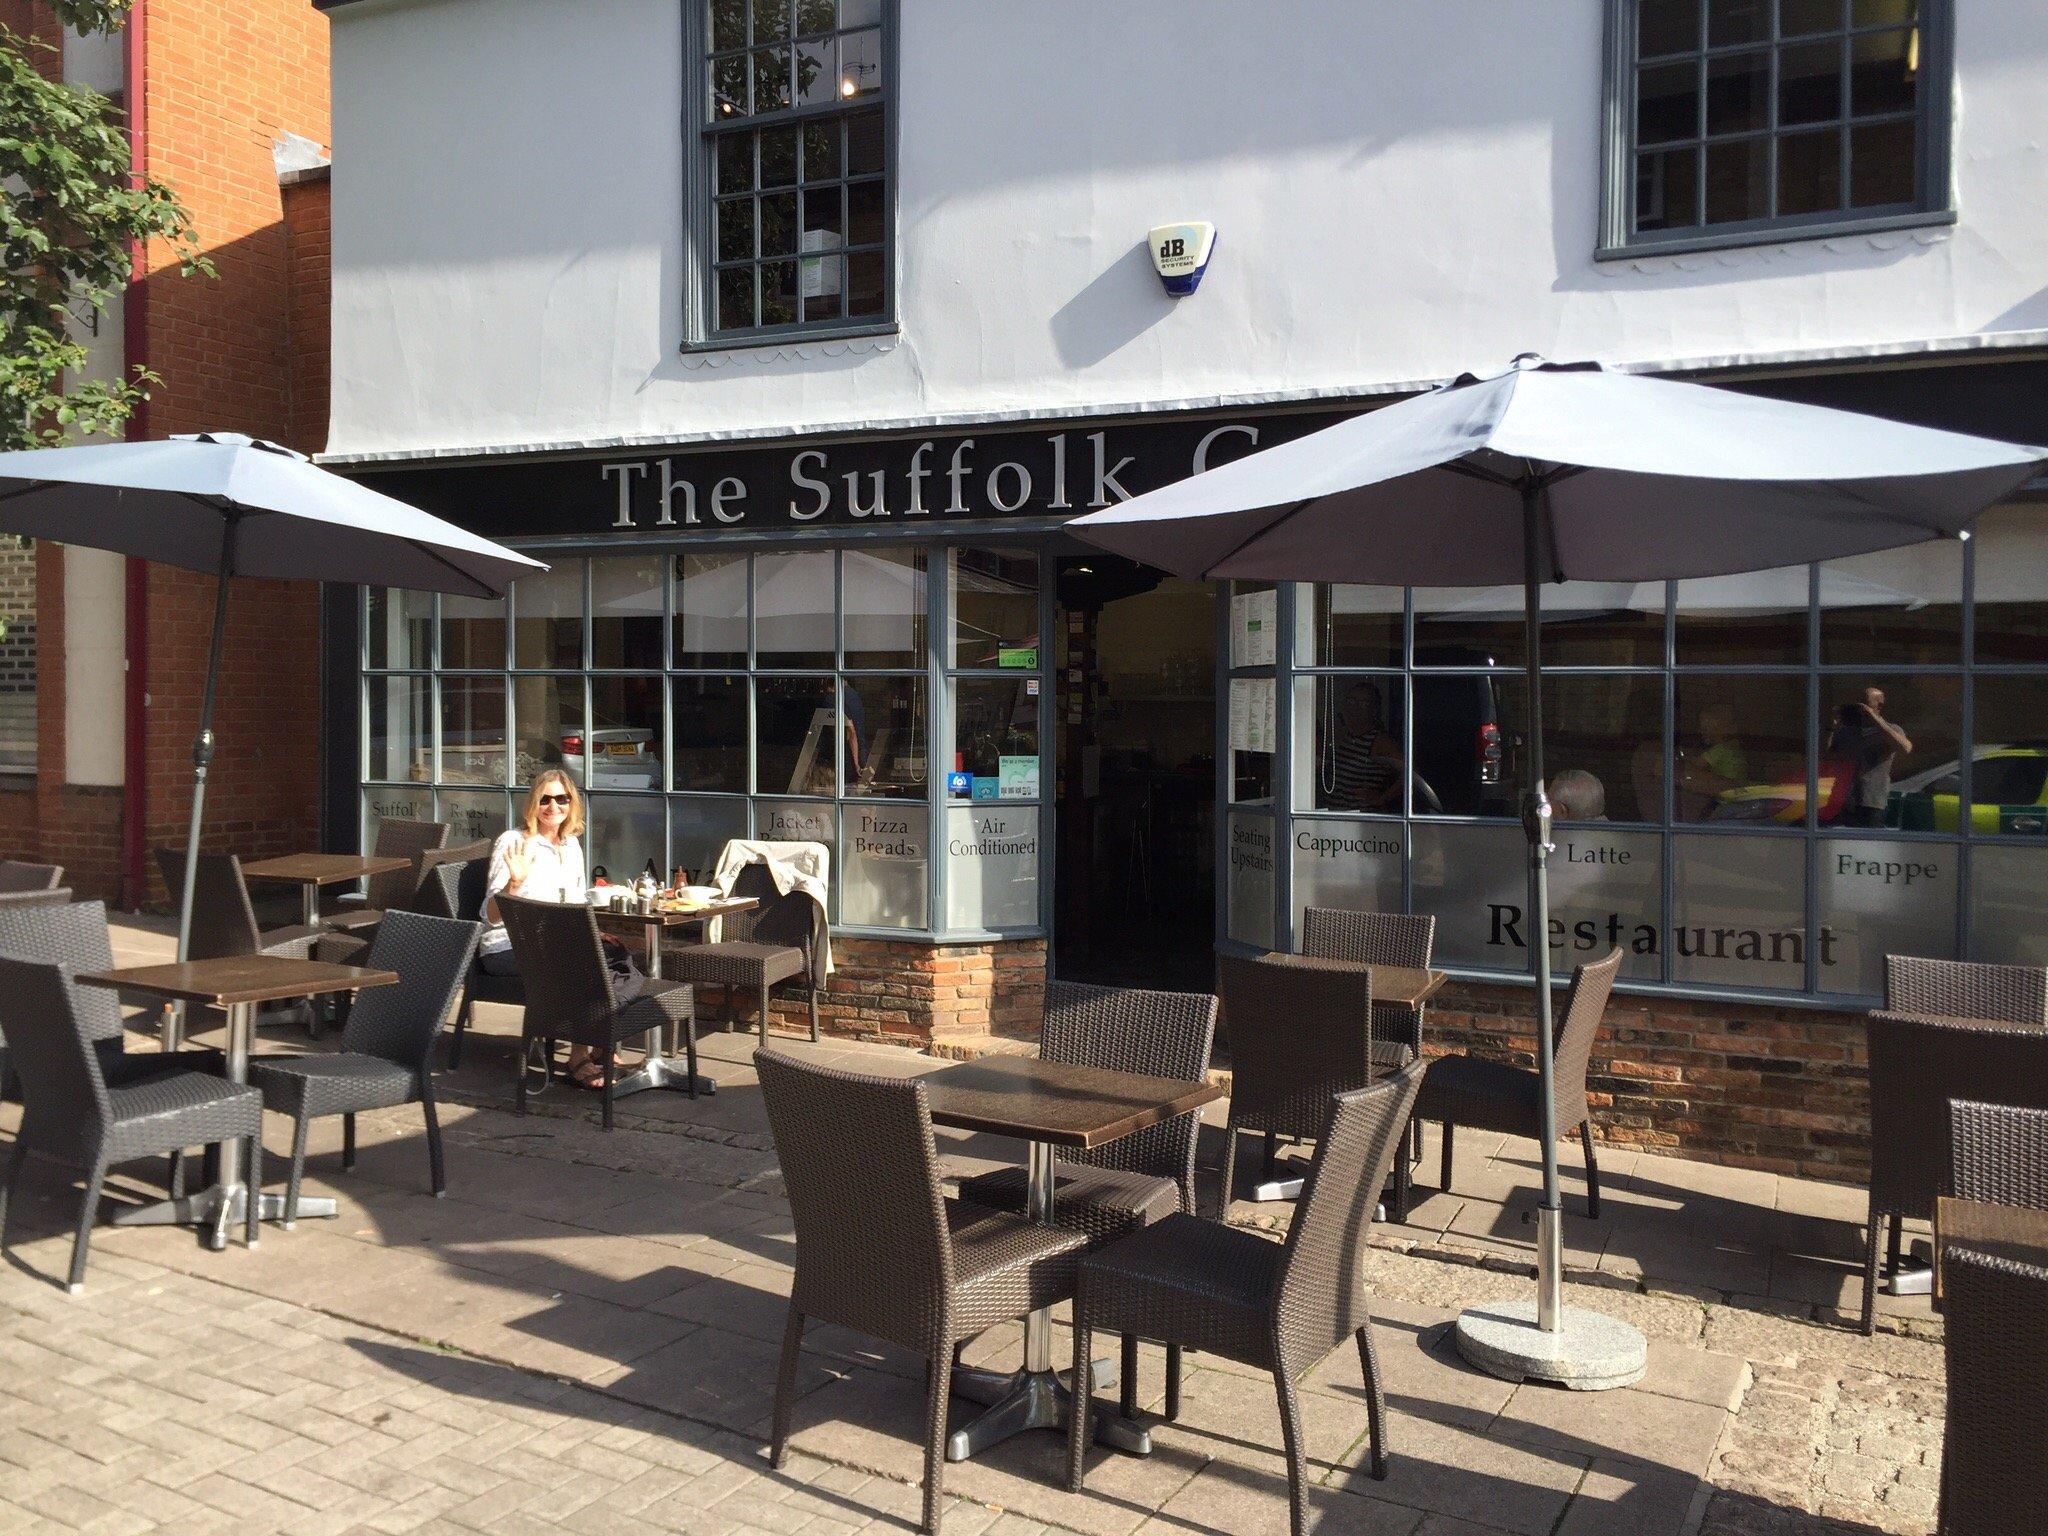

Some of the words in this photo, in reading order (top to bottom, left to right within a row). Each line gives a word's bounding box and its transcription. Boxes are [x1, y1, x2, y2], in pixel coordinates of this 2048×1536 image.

[1160, 238, 1184, 258] dB
[1160, 255, 1195, 264] SECURITY
[1161, 261, 1194, 269] SYSTEMS
[602, 458, 747, 528] The
[788, 432, 1137, 522] Suffolk
[768, 812, 822, 831] Jacket
[861, 816, 909, 834] Pizza
[981, 818, 1006, 834] Air
[855, 837, 915, 856] Breads
[949, 838, 1036, 856] Conditioned
[1233, 824, 1271, 853] Seating
[1296, 832, 1400, 858] Cappuccino
[1231, 846, 1273, 872] Upstairs
[1567, 843, 1631, 866] Latte
[1836, 853, 1939, 884] Frappe
[1486, 903, 1837, 966] Restaurant
